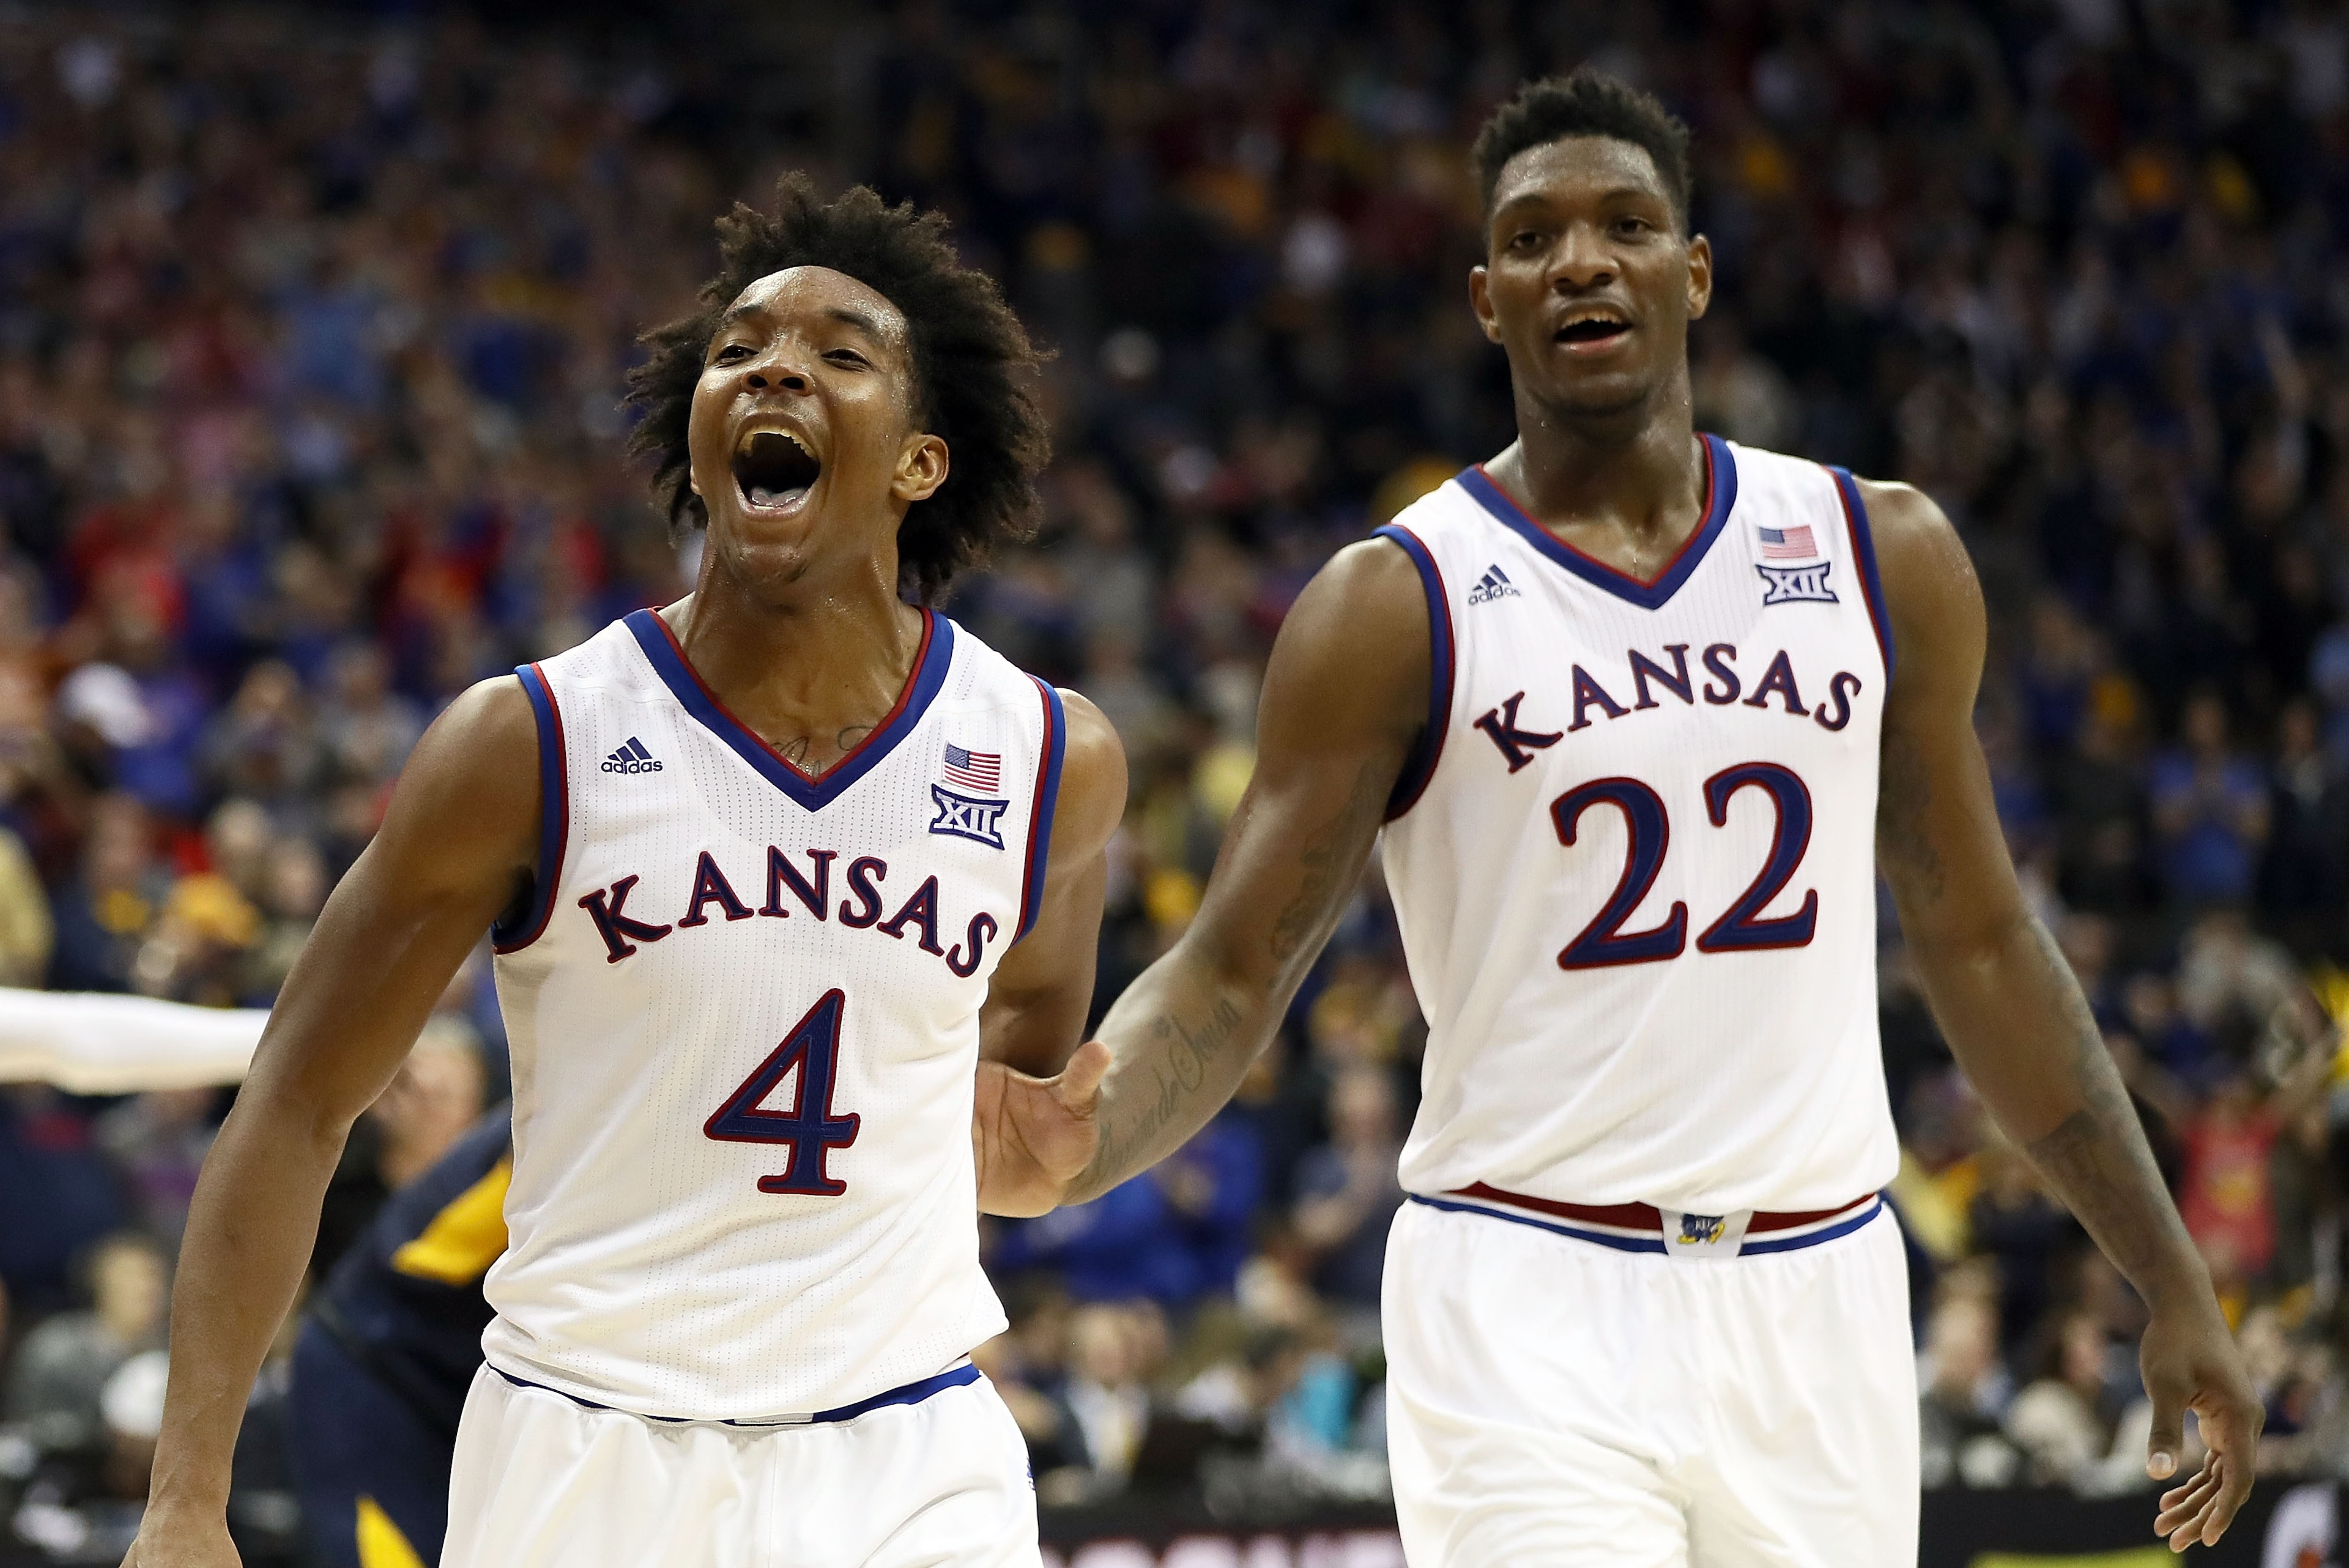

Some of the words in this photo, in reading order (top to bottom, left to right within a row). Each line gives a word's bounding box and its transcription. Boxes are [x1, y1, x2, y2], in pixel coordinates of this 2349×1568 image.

[1468, 585, 1521, 606] adidas
[1761, 567, 1835, 604] XII
[1472, 642, 1862, 775] KANSAS
[601, 760, 663, 775] adidas
[933, 790, 1003, 843] XII
[577, 845, 998, 978] KANSAS
[1550, 762, 1817, 971] 22
[703, 988, 861, 1196] 4
